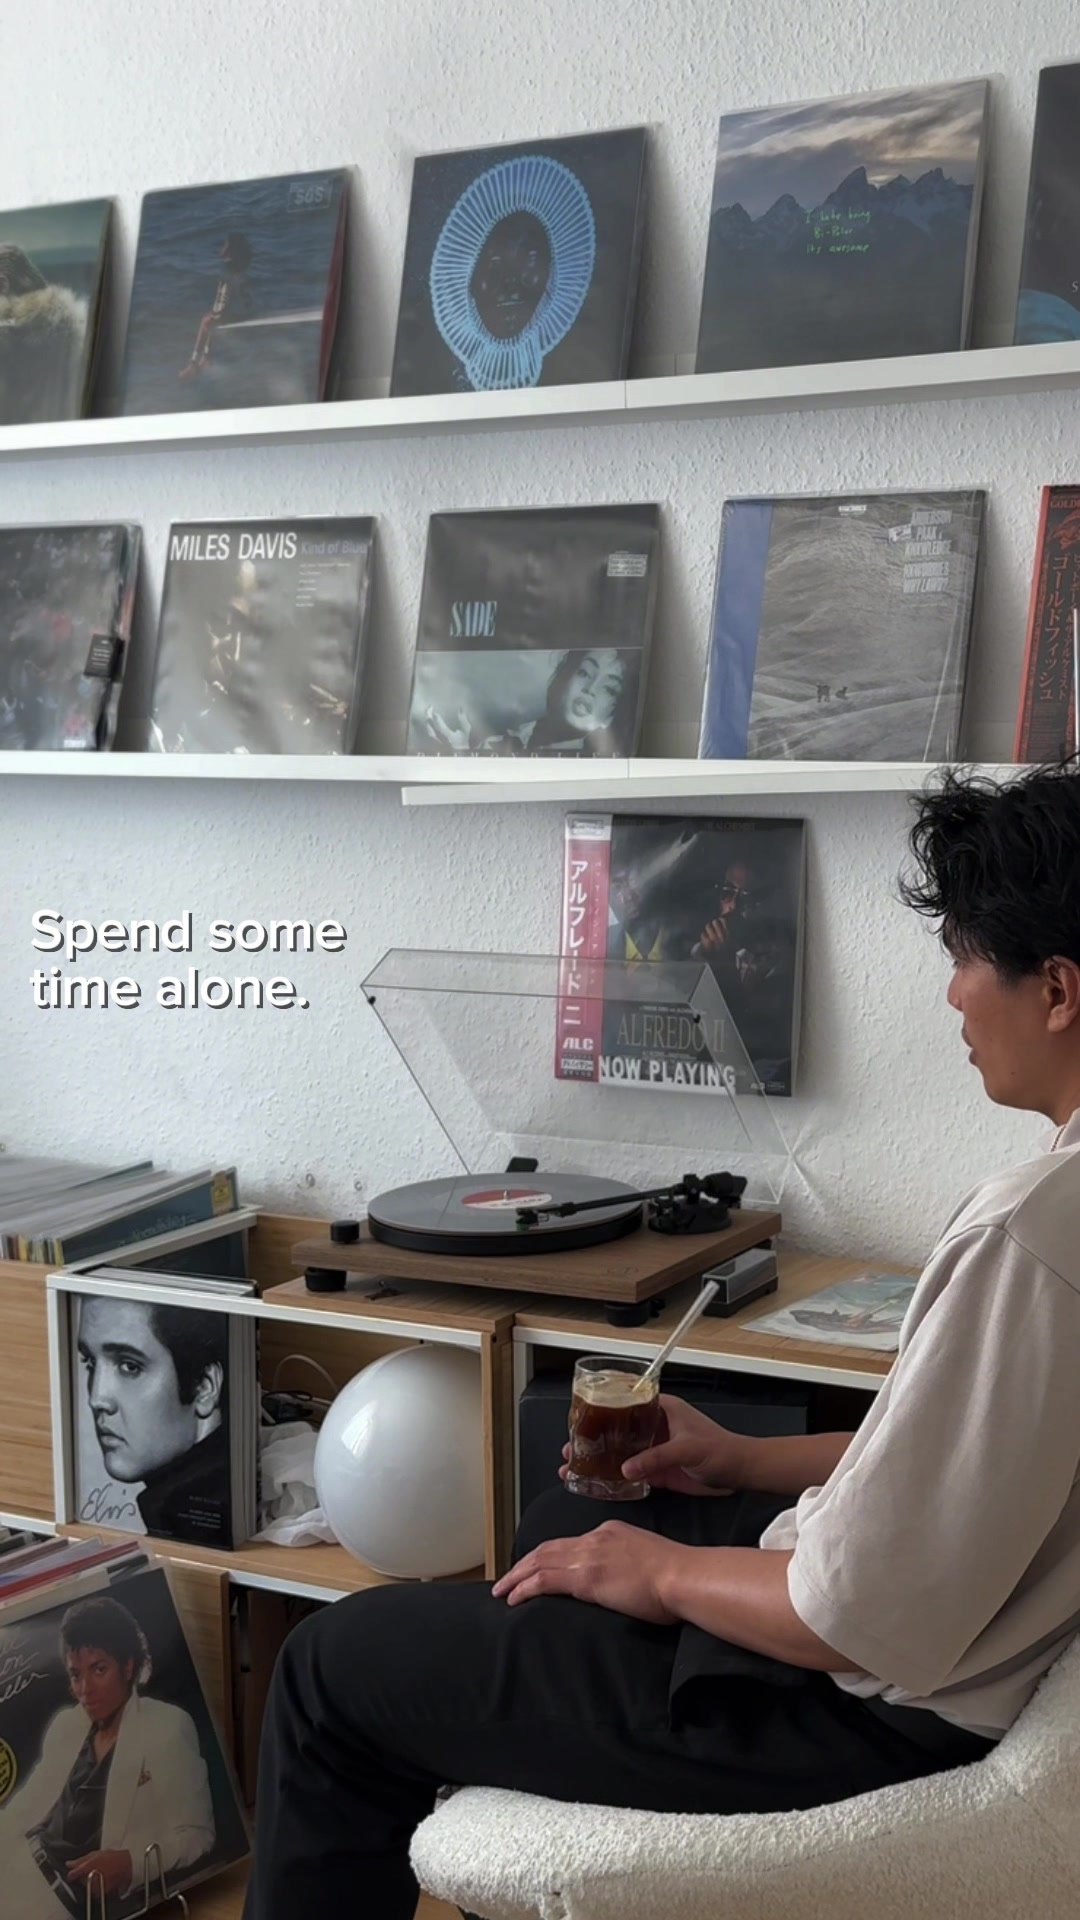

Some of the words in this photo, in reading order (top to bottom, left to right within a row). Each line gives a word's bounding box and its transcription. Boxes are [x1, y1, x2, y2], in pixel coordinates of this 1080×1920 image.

[170, 533, 231, 561] MILES
[238, 532, 297, 559] DAVIS
[450, 600, 497, 637] SADE
[616, 1013, 708, 1052] ALFREDO
[599, 1055, 641, 1080] NOW
[650, 1060, 736, 1088] PLAYING
[80, 1482, 136, 1523] Elvis
